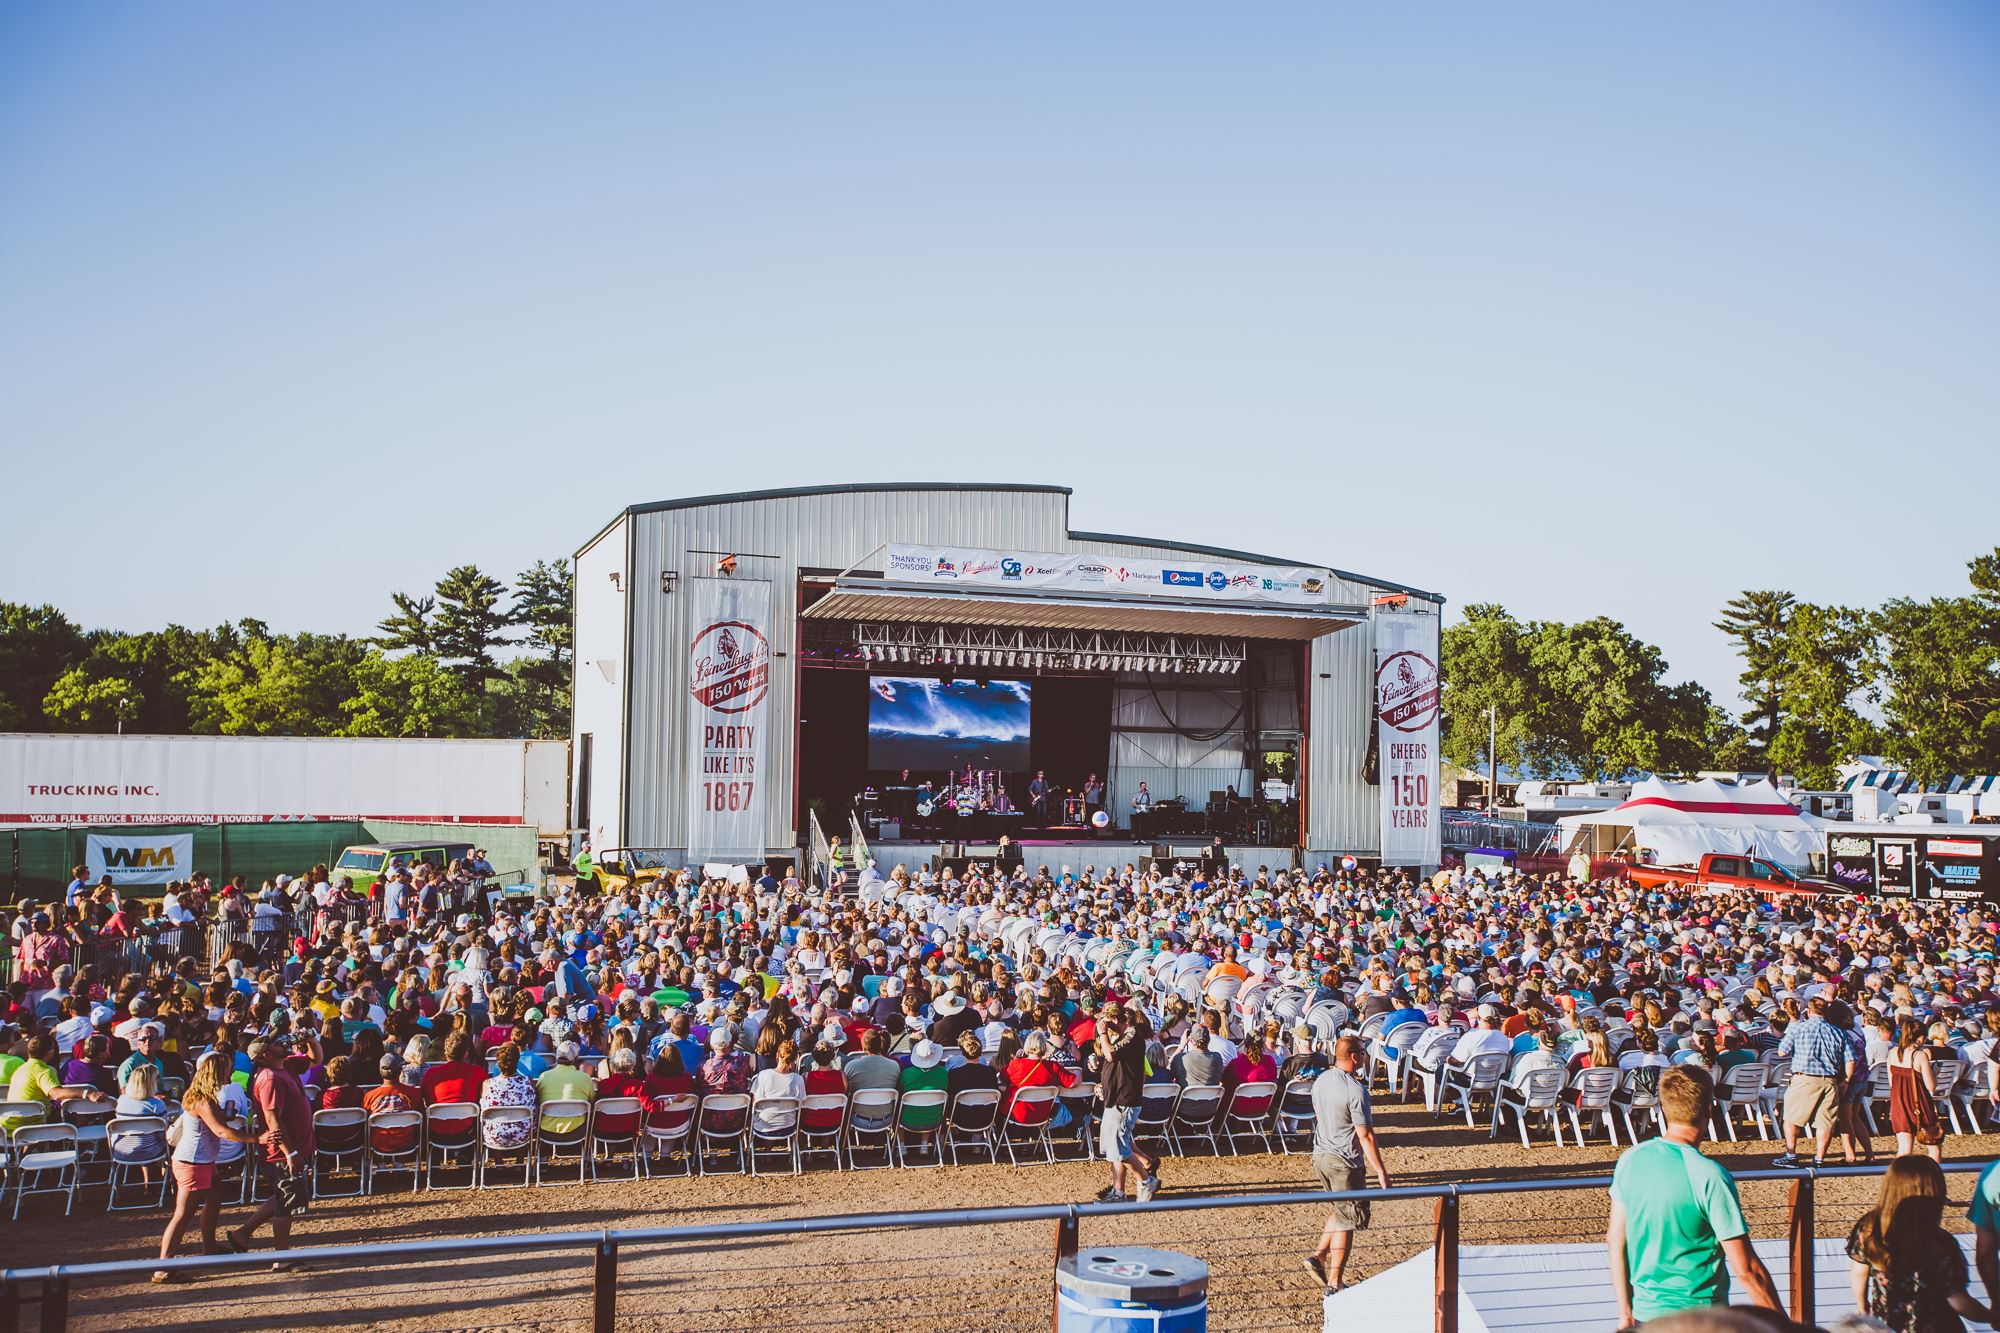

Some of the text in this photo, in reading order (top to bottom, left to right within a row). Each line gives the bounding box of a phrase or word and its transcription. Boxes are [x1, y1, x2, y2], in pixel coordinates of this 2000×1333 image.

[890, 562, 932, 572] SPONSORS!
[891, 554, 932, 565] THANK YOU
[1077, 564, 1107, 573] CHILSON
[709, 674, 765, 702] 150 Years
[1393, 696, 1436, 722] 150 Years
[705, 725, 755, 749] PARTY
[1391, 743, 1427, 760] CHEERS
[704, 756, 755, 774] LIKE IT'S
[1405, 761, 1414, 772] TO
[28, 785, 160, 796] TRUCKING INC.
[703, 782, 755, 812] 1867
[1391, 775, 1428, 807] 150
[30, 814, 264, 824] YOUR FULL SERVICE TRANSPORTATION PROVIDER
[1391, 810, 1428, 828] YEARS
[103, 846, 175, 867] WM
[1942, 889, 1984, 899] DETROIT
